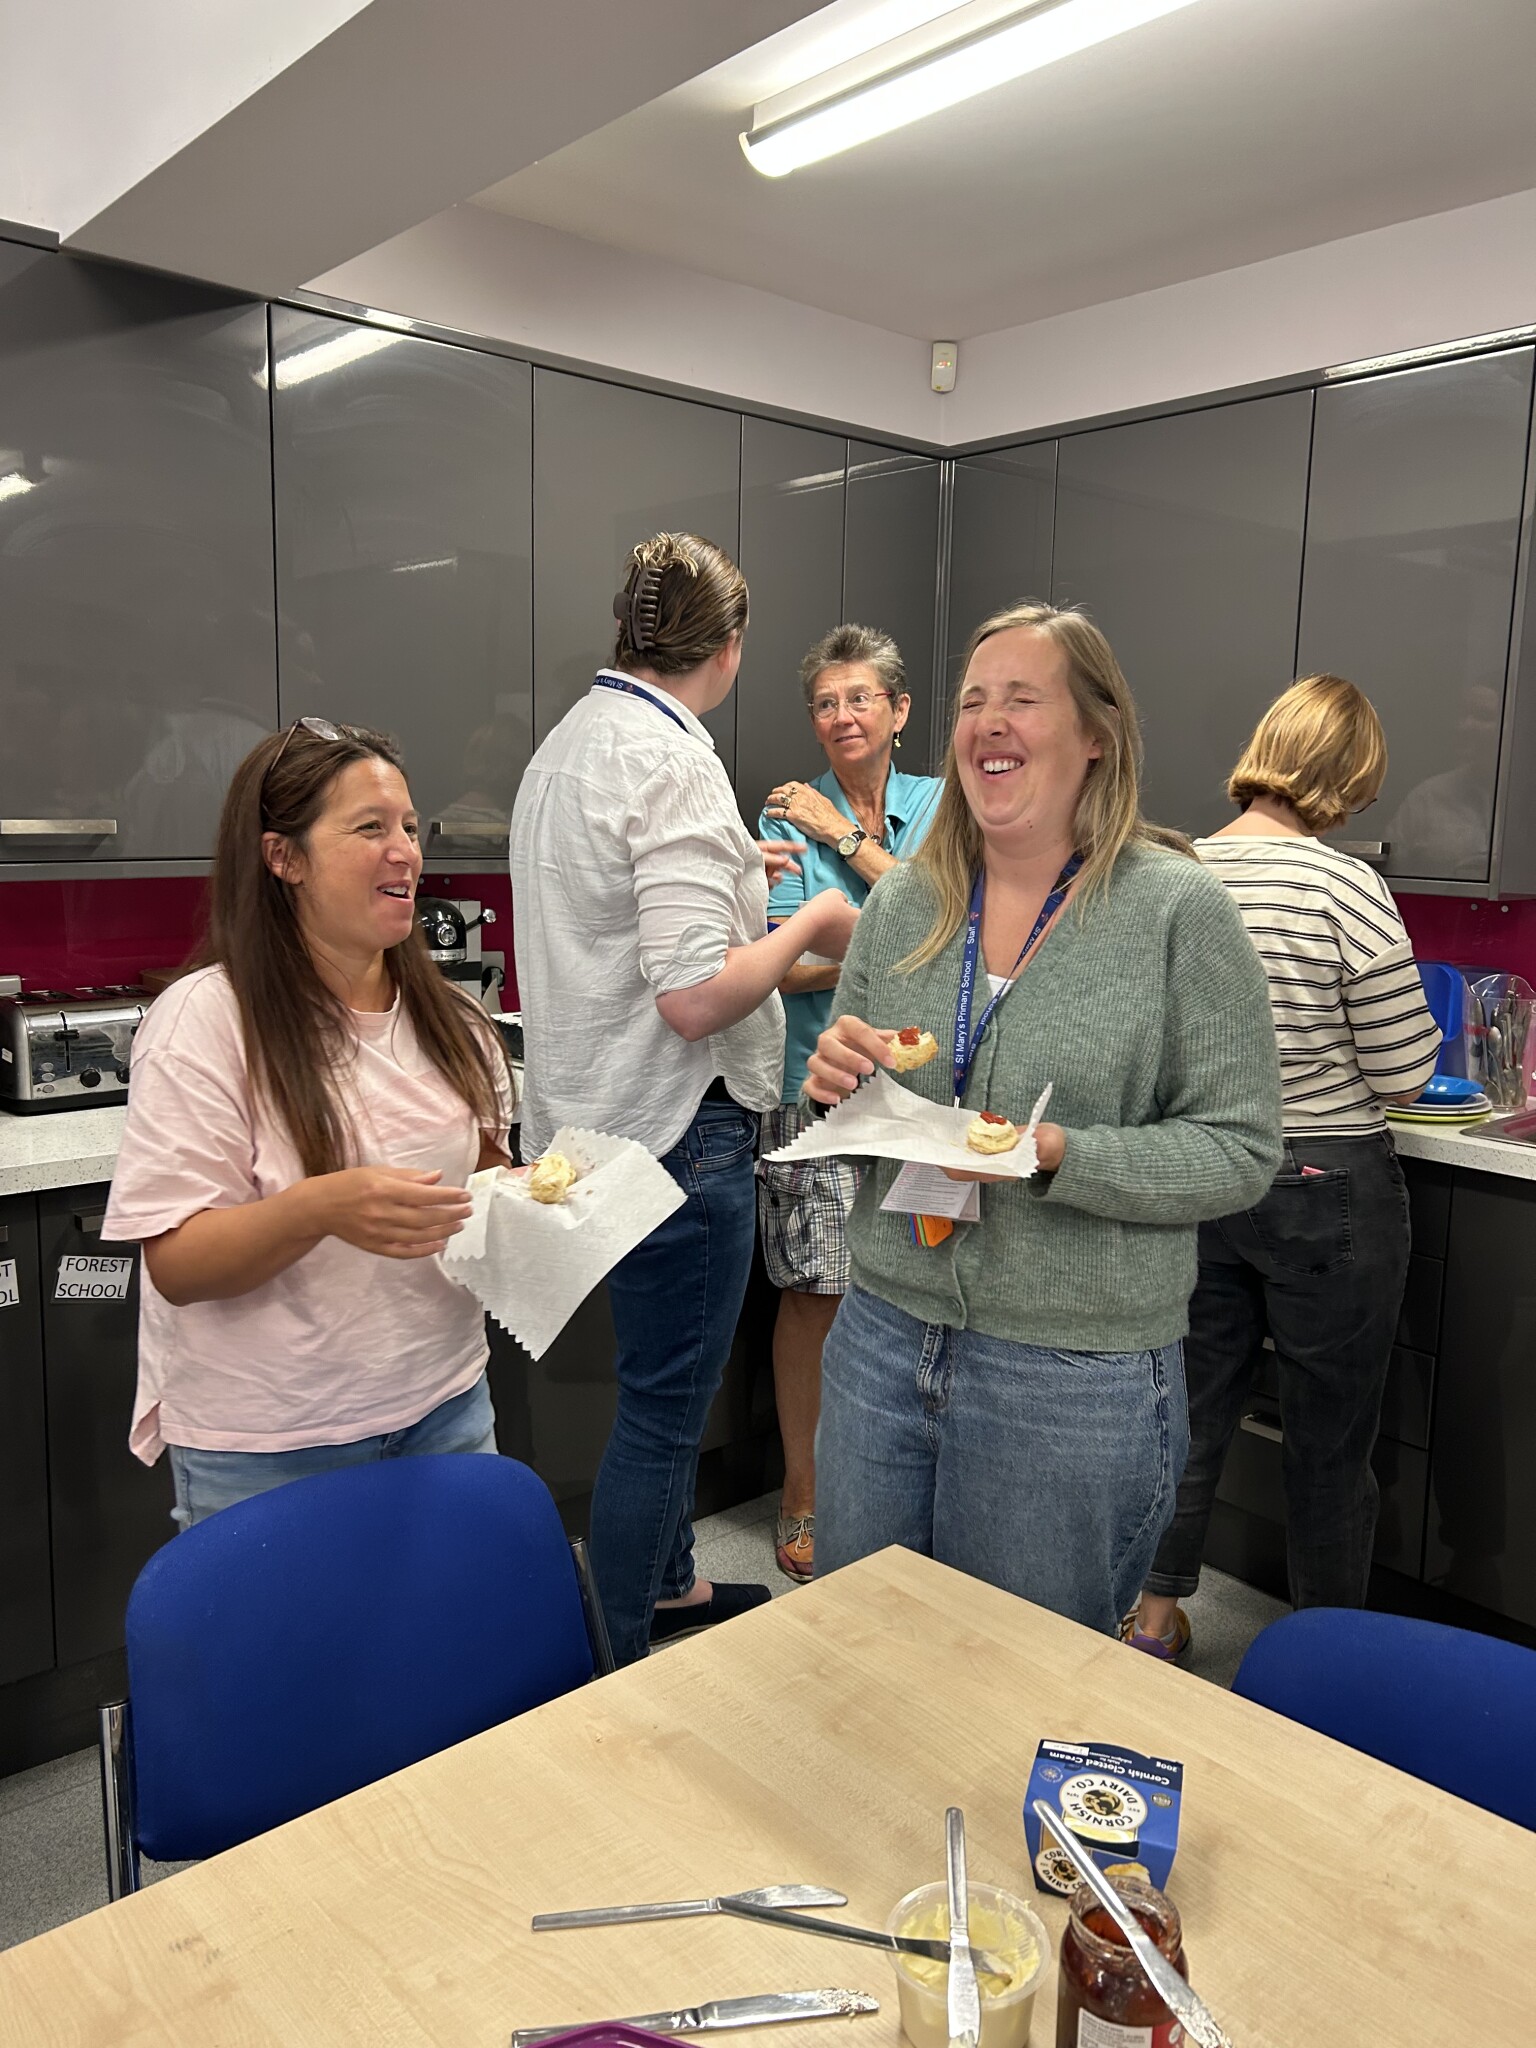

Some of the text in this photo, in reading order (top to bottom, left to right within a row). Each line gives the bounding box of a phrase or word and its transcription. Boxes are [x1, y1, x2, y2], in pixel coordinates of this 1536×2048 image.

[966, 926, 976, 945] Staff
[960, 960, 973, 993] School
[957, 990, 971, 1023] Primary
[979, 997, 998, 1026] School
[955, 1022, 968, 1050] Mary's
[955, 1050, 965, 1065] St
[65, 1257, 129, 1273] FOREST
[56, 1283, 125, 1298] SCHOOL
[1049, 1751, 1171, 1786] Cornish Clotted Cream
[1071, 1778, 1095, 1789] CO.
[1099, 1779, 1139, 1804] DAIRY
[1069, 1802, 1134, 1828] CORNISH
[1042, 1869, 1070, 1890] DAIRY
